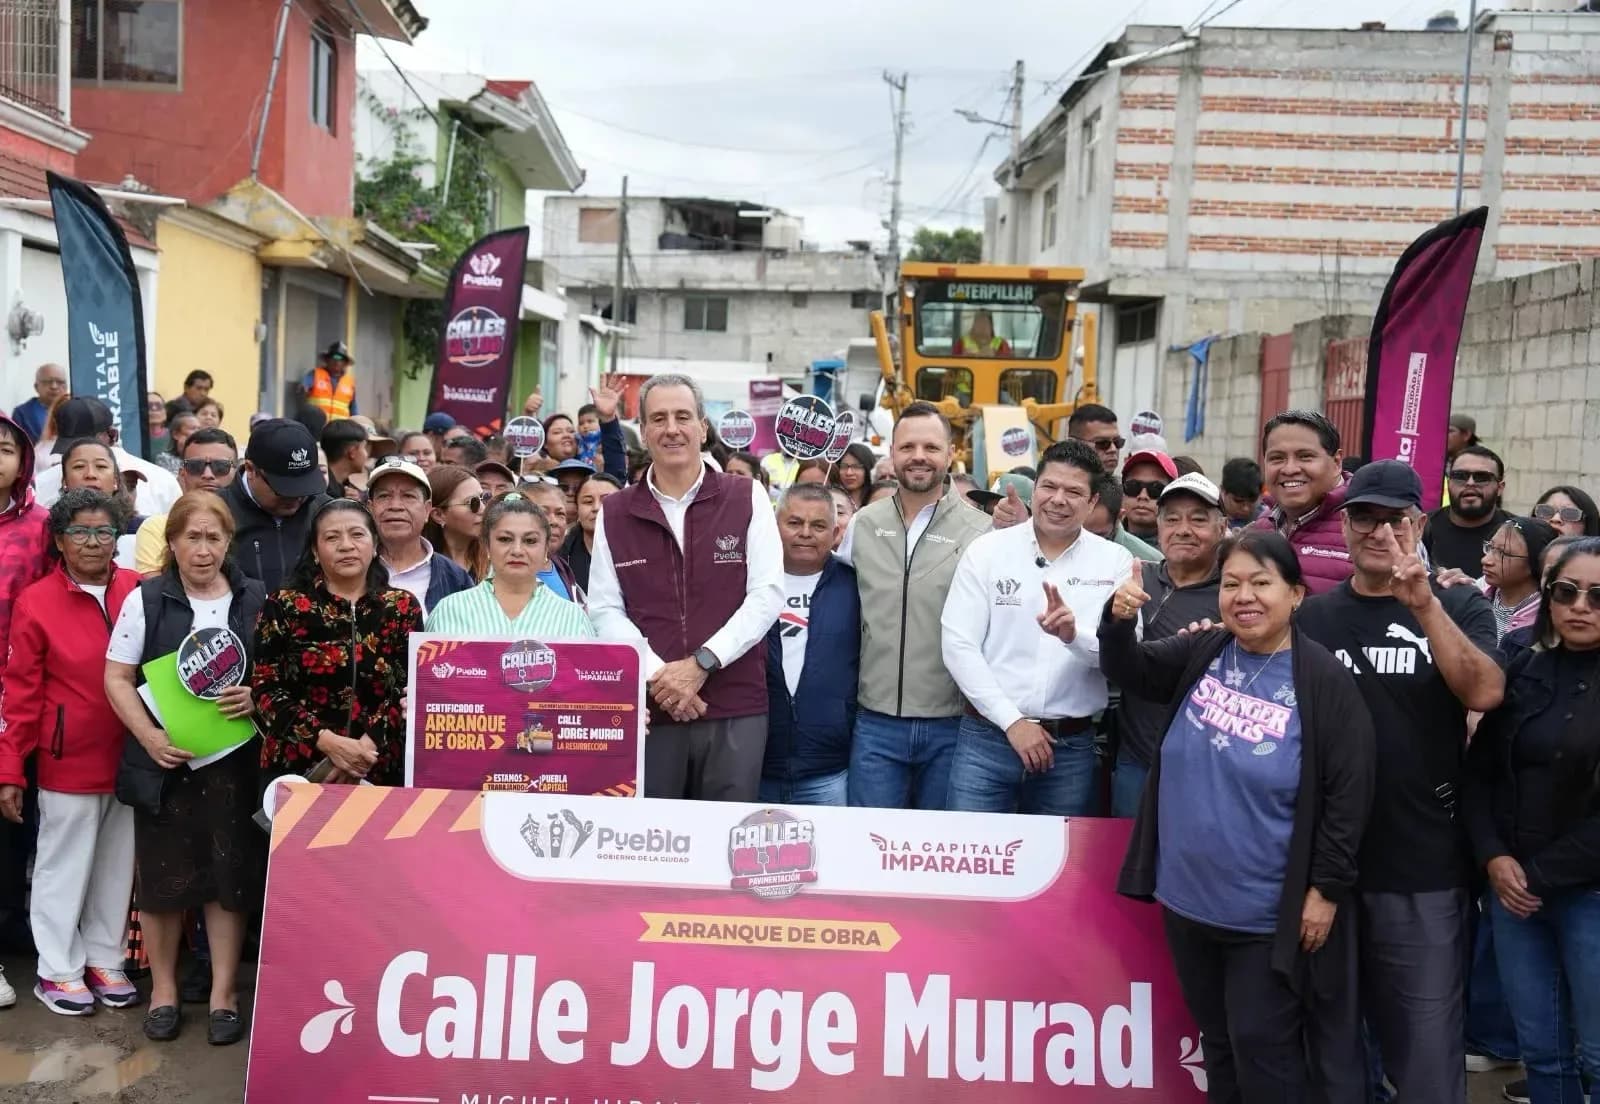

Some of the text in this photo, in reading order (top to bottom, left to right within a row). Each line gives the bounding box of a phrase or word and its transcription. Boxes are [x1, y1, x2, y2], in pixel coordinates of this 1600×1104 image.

[947, 283, 1034, 300] CATERPILLAR
[96, 347, 107, 399] ITAL
[782, 402, 834, 435] CALLES
[714, 551, 742, 560] Puebla
[179, 630, 232, 684] CALLES
[502, 651, 553, 670] CALLES
[1335, 647, 1416, 674] PMA
[456, 667, 487, 677] Puebla
[426, 703, 485, 714] CERTIFICADO DE
[1192, 676, 1291, 737] STRANGER
[425, 713, 506, 732] ARRANQUE
[557, 715, 582, 725] CALLE
[1200, 702, 1264, 742] THINGS
[425, 732, 486, 750] DE OBRA
[557, 727, 624, 740] JORGE MURAD
[557, 742, 565, 750] LA
[493, 774, 523, 782] ESTAMOS
[597, 827, 691, 853] Puebla
[730, 820, 814, 848] CALLES
[597, 853, 636, 861] GOBIERNO
[890, 840, 1003, 856] LA CAPITAL
[881, 853, 1015, 876] IMPARABLE
[748, 872, 801, 886] PAVIMENTACIÓN
[661, 921, 881, 946] ARRANQUE DE OBRA
[377, 950, 1154, 1091] Calle Jorge Murad
